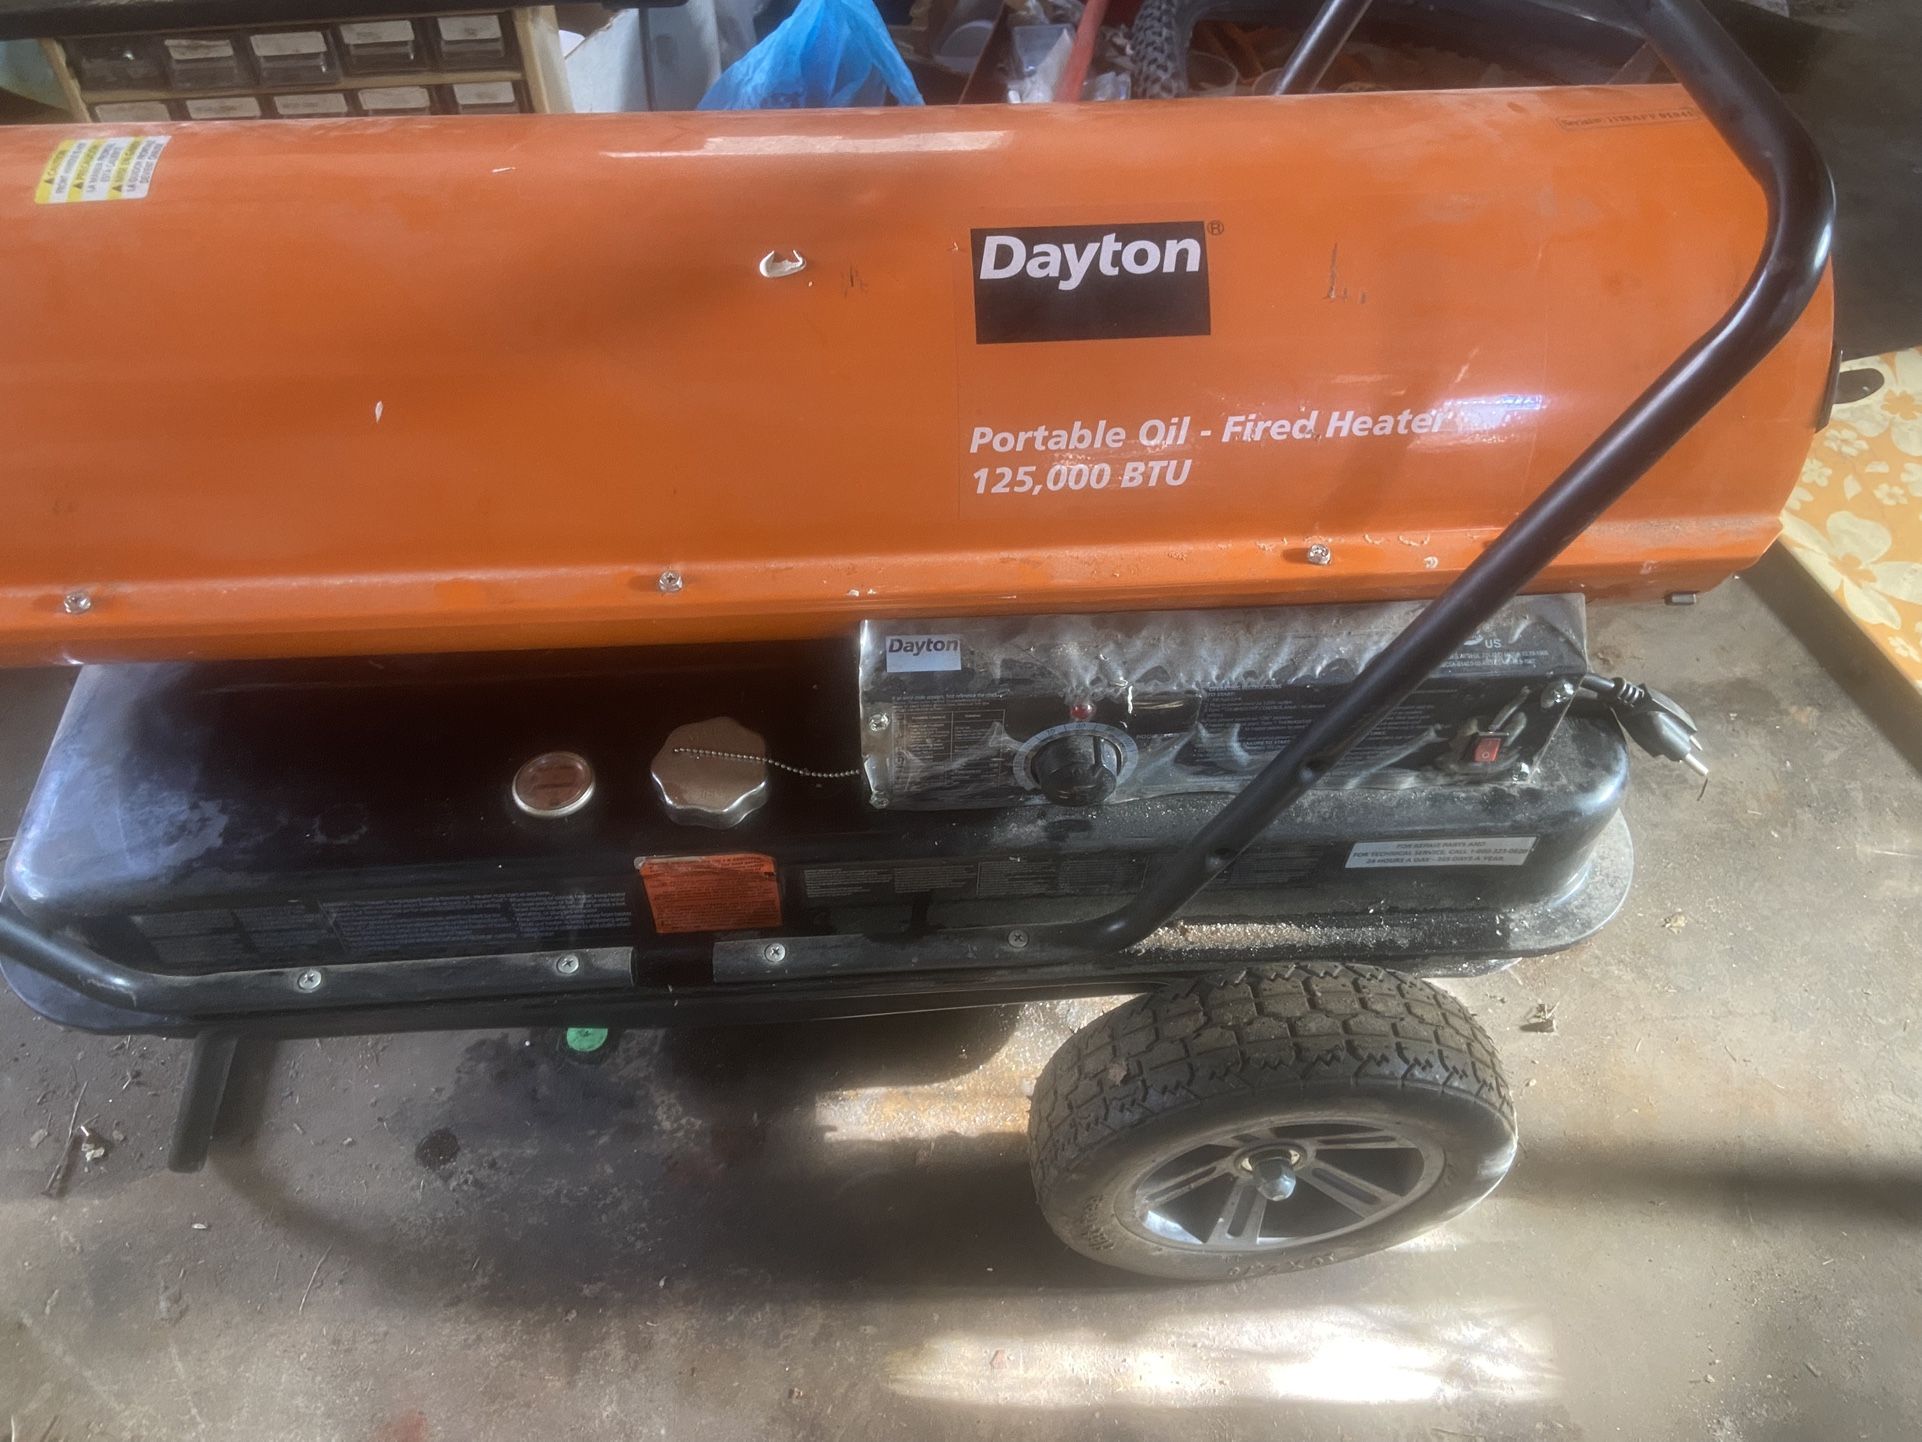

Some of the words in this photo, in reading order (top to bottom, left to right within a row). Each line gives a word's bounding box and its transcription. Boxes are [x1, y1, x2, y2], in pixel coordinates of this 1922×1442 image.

[979, 233, 1201, 291] Dayton
[968, 419, 1127, 454] Portable
[1138, 416, 1190, 449] Oil
[1221, 411, 1318, 443] Fired
[1326, 409, 1448, 438] Heater
[972, 464, 1111, 496] 125,000
[1120, 460, 1192, 489] BTU
[889, 638, 958, 656] Dayton
[1485, 638, 1502, 648] US
